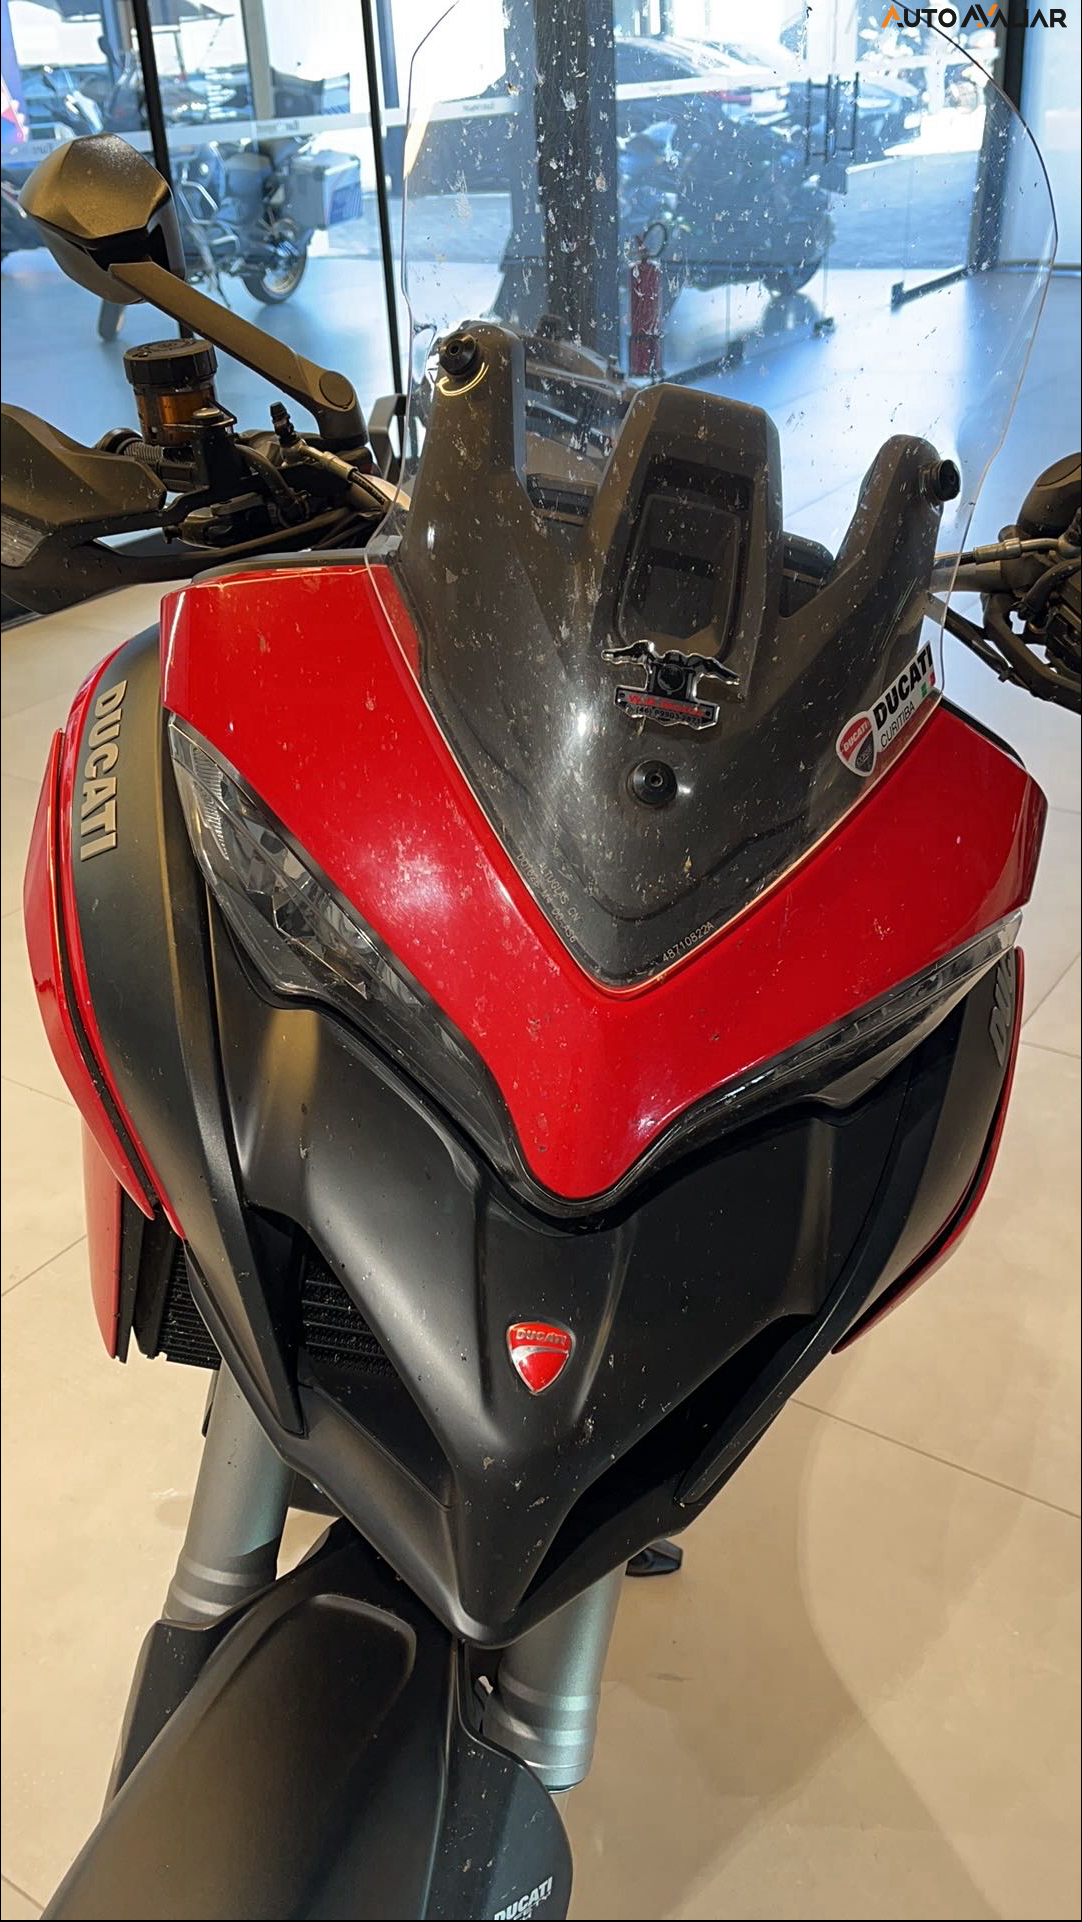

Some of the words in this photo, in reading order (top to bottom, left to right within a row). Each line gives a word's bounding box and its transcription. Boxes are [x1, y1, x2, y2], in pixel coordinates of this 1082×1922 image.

[873, 645, 933, 731] DUCATI
[843, 722, 869, 752] DUCATI
[880, 701, 916, 748] CURITIBA
[80, 679, 128, 862] DUCATI
[662, 920, 714, 962] 48710822A
[516, 1329, 567, 1345] DUCATI
